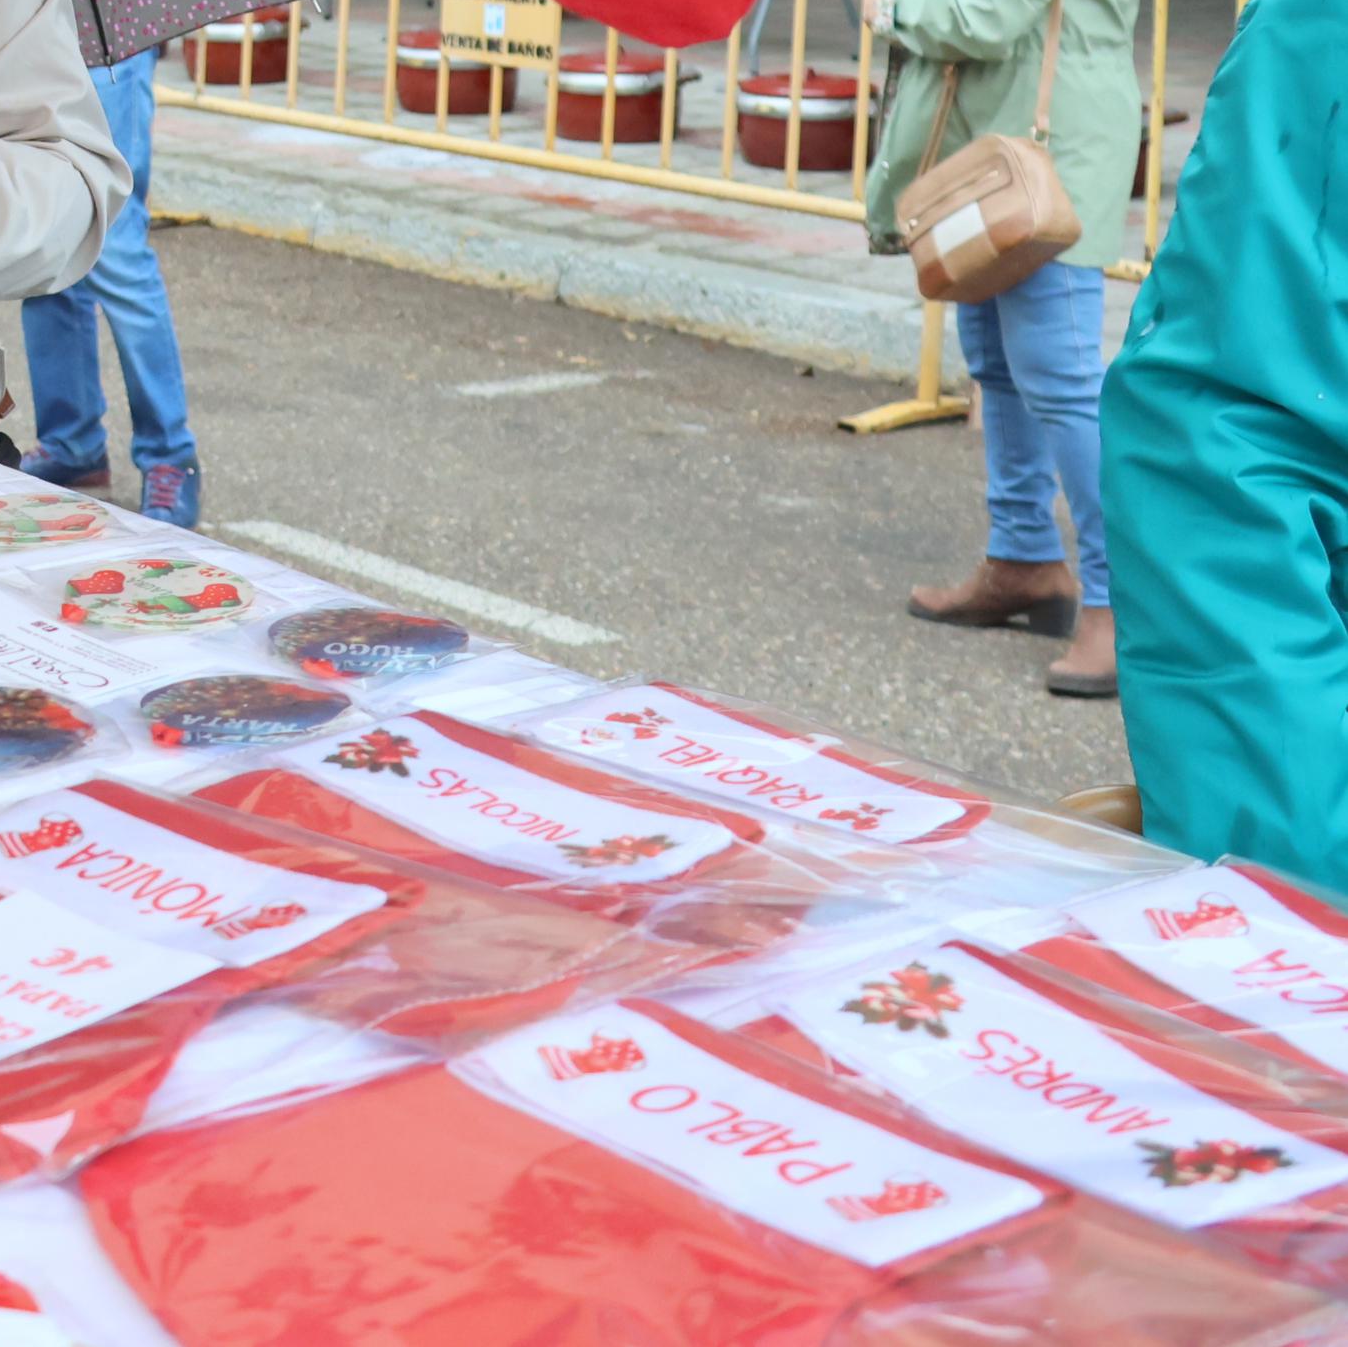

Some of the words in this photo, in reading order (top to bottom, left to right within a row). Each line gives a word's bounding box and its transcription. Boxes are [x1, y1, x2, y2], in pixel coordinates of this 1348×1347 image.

[441, 33, 483, 50] VENTA
[508, 37, 554, 60] BAÑOS
[323, 642, 415, 656] HUGO
[181, 713, 298, 733] MARTA
[416, 767, 582, 842] NICOLÁS
[657, 734, 826, 810] RAQUEL
[54, 841, 252, 928] MÓNICA
[6, 979, 104, 1020] PAPÁ
[958, 1028, 1172, 1136] ANDRÉS
[628, 1084, 854, 1185] PABLO
